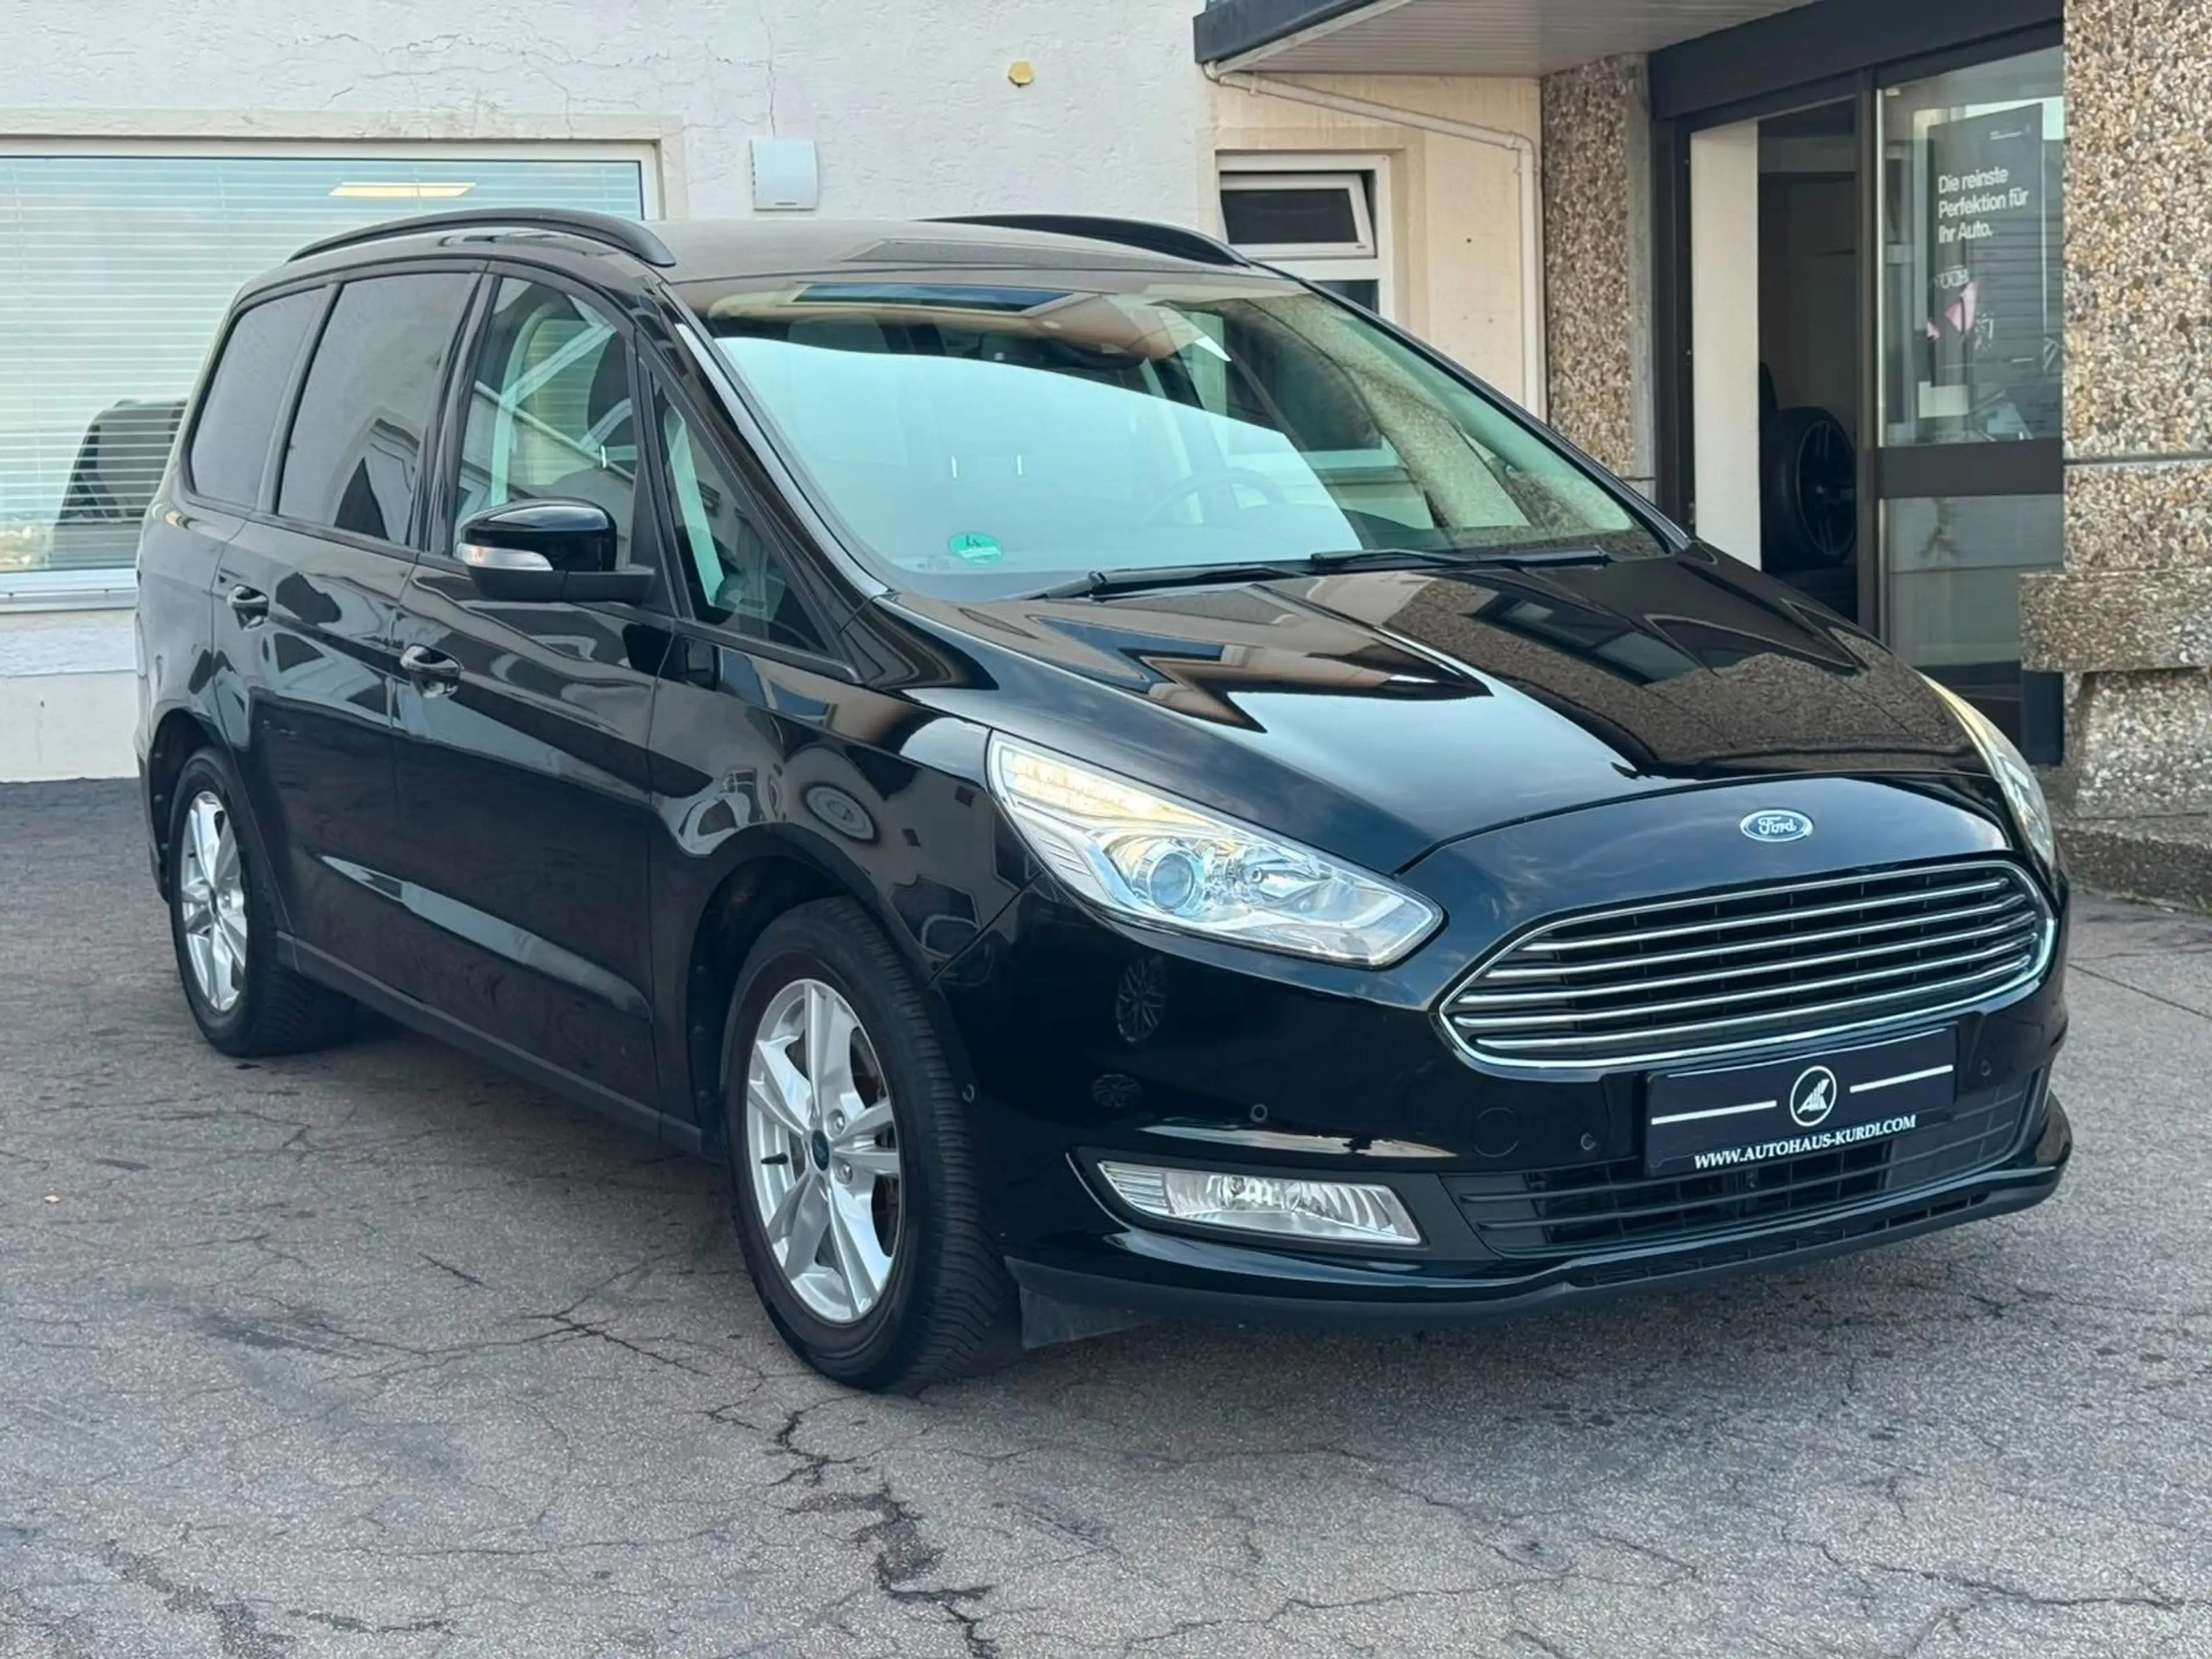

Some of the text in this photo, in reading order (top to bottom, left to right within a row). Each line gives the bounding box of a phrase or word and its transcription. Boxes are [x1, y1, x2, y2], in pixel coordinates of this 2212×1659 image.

[1938, 166, 2009, 194] Die reinste
[1938, 187, 2029, 219] Perfektion für
[1938, 220, 1993, 244] Ihr Auto.
[1758, 816, 1797, 835] Ford
[1694, 1114, 1917, 1169] WWW.AUTOHAUS-KURDI.COM
